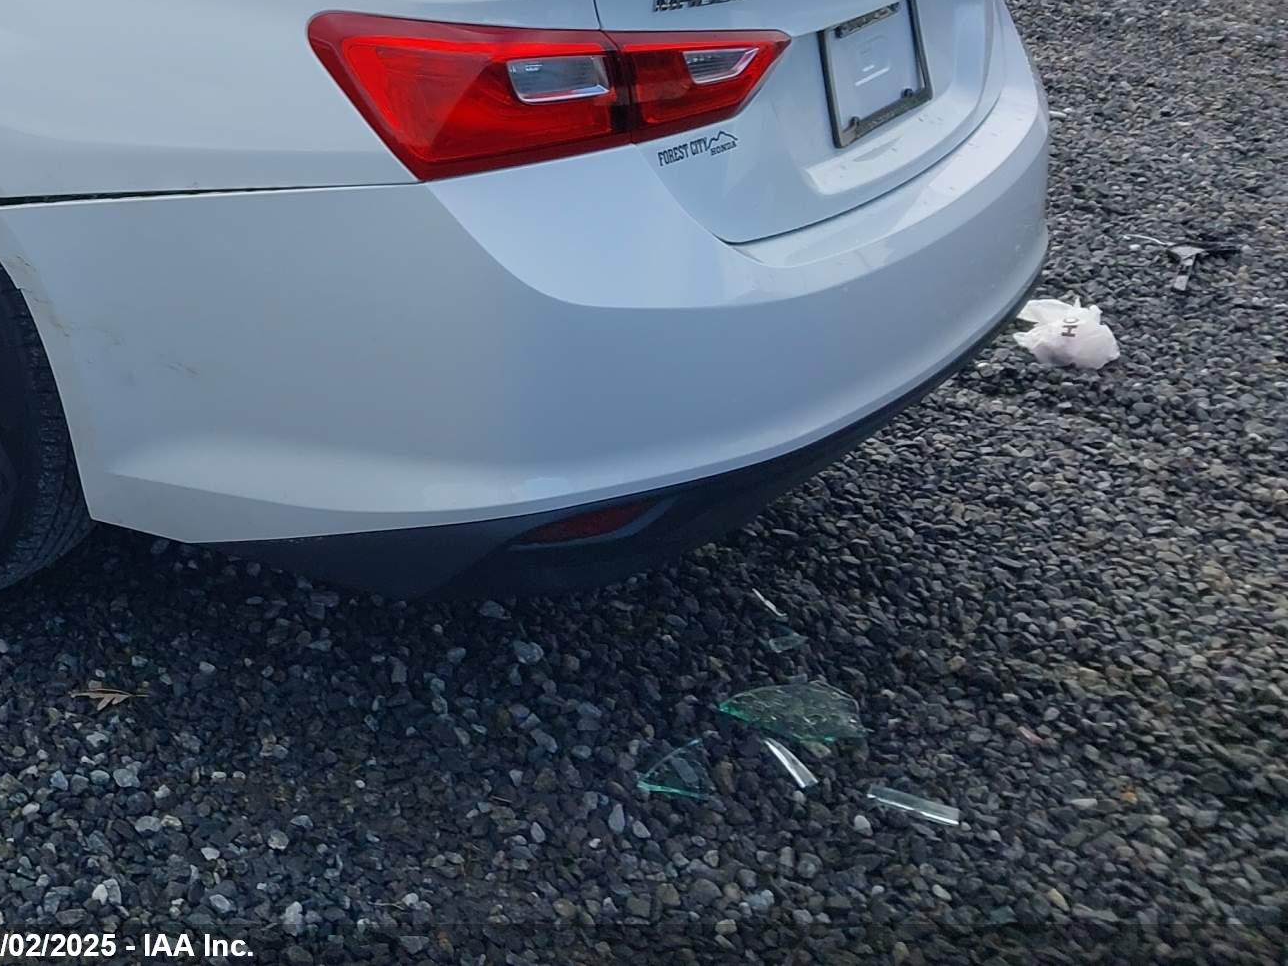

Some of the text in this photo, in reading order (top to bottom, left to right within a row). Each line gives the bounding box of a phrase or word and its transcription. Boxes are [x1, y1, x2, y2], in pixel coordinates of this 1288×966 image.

[657, 136, 711, 167] FOREST CITY
[710, 140, 737, 156] HONDA
